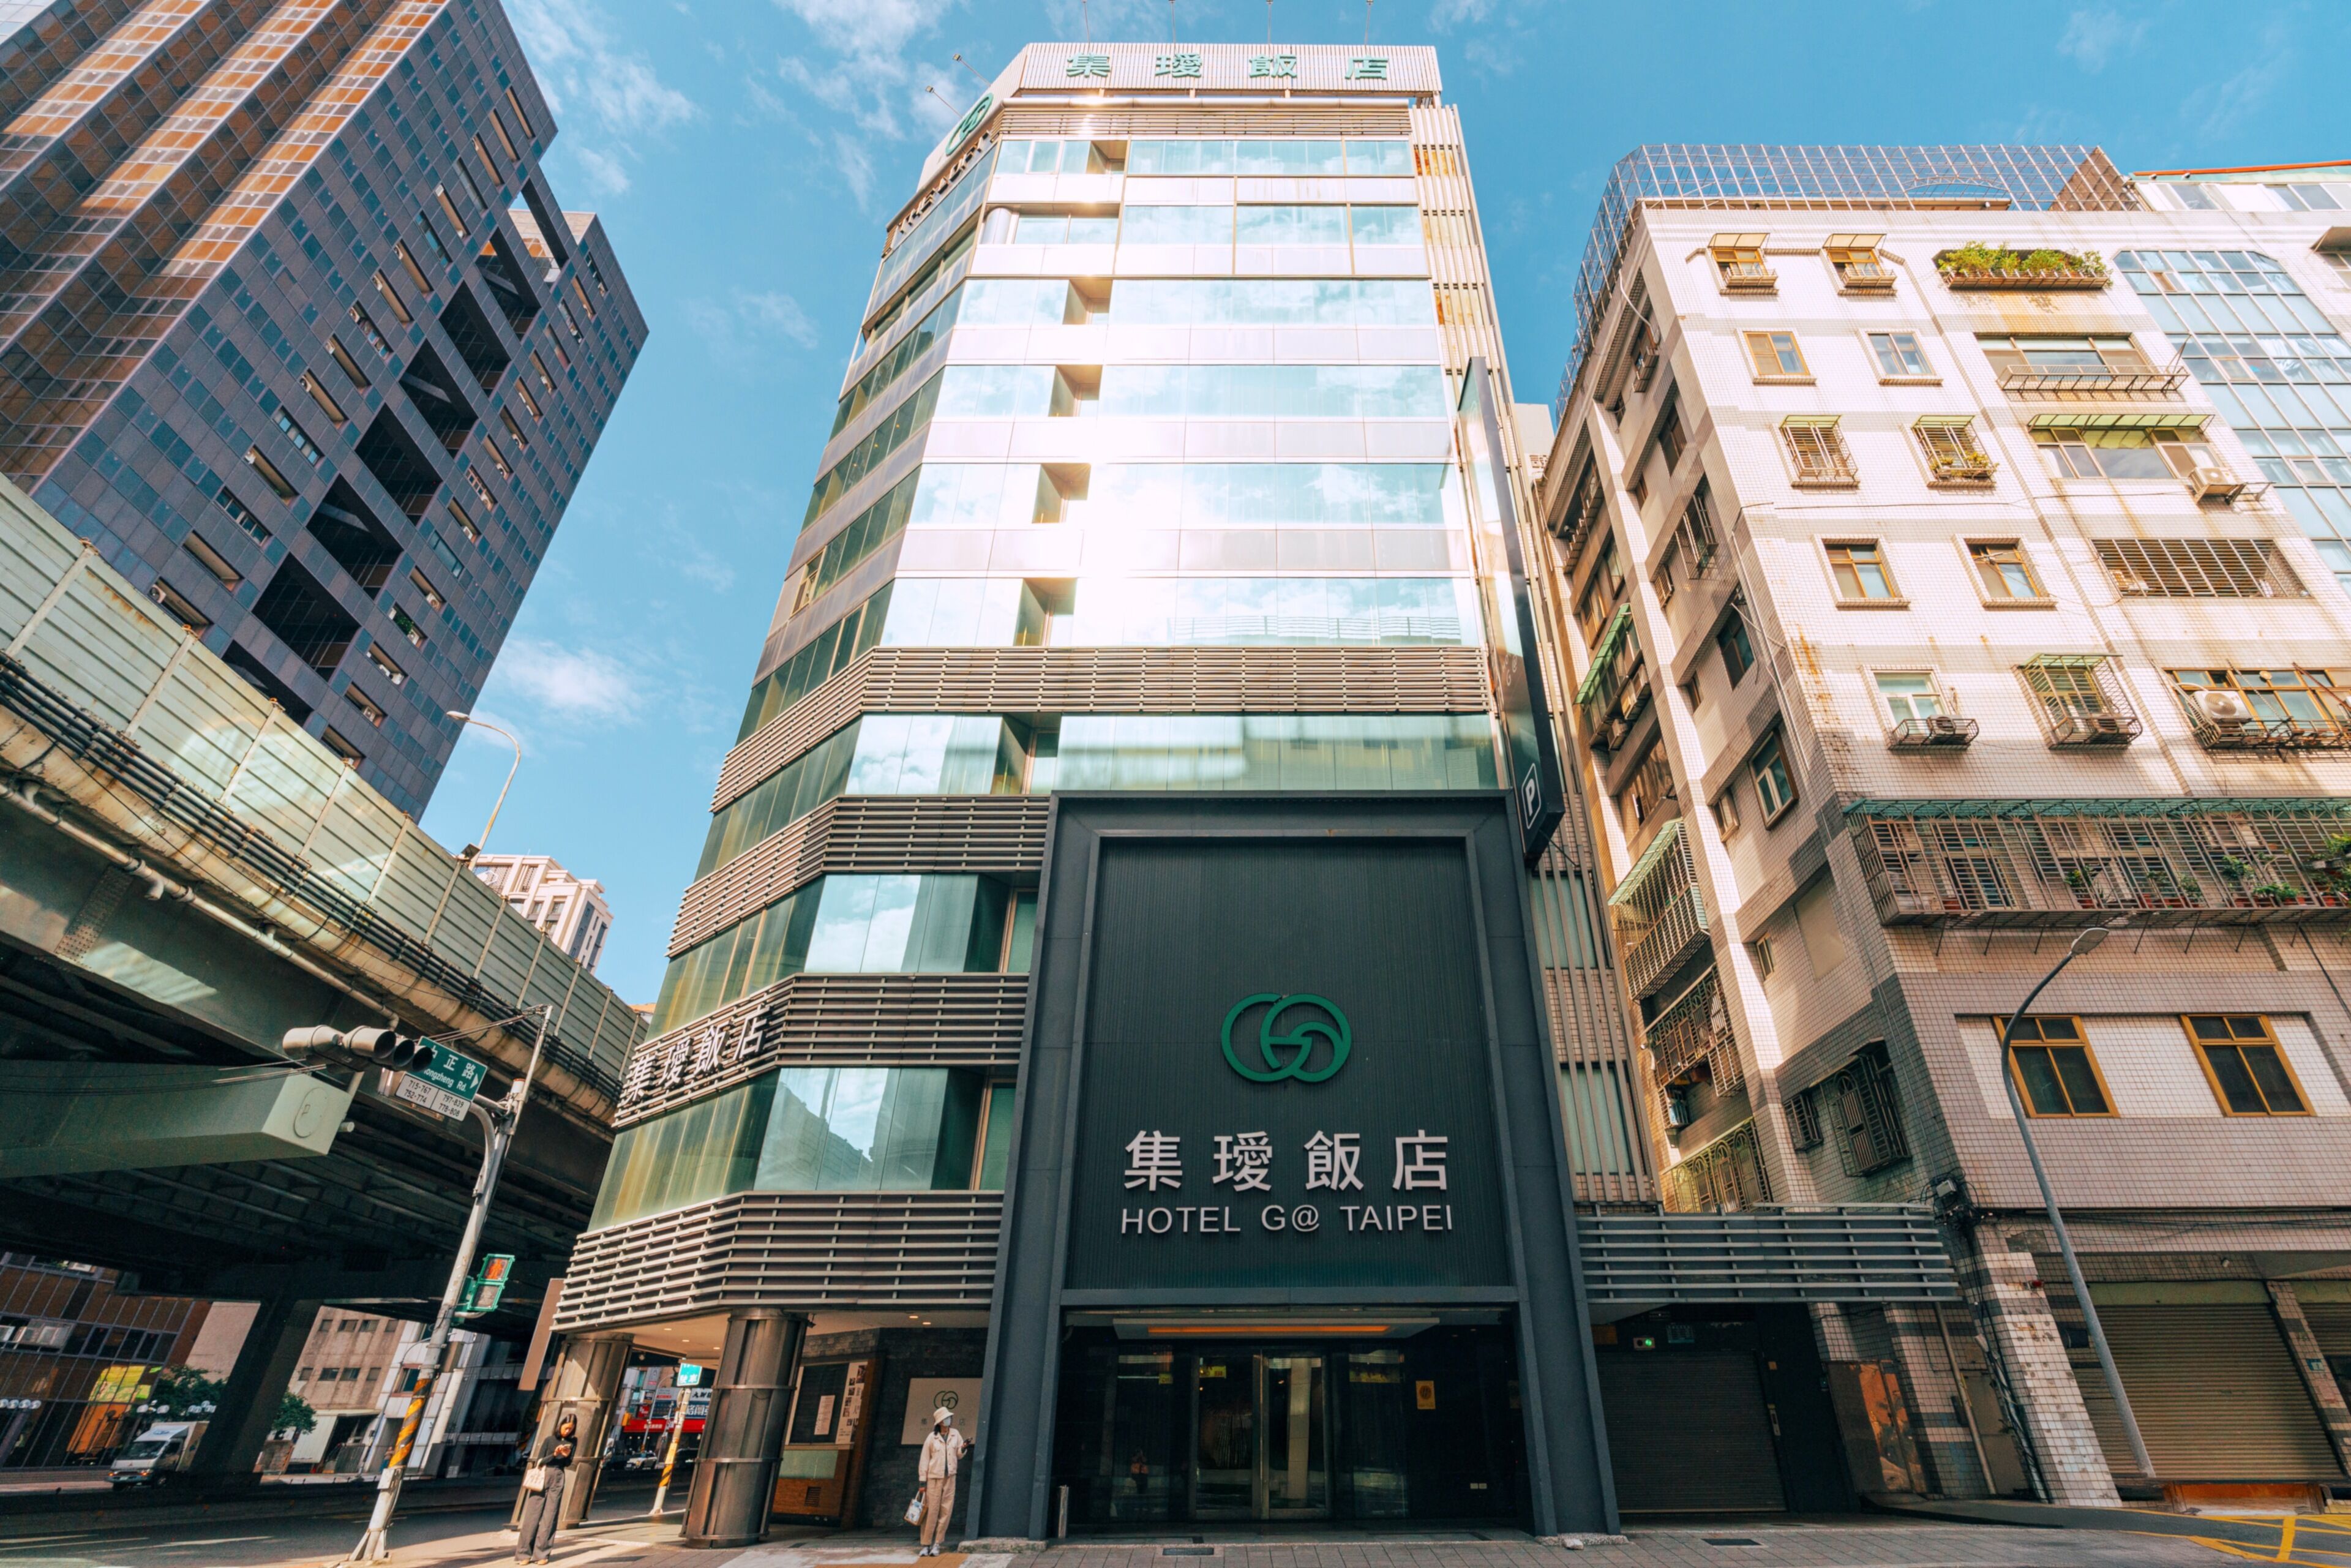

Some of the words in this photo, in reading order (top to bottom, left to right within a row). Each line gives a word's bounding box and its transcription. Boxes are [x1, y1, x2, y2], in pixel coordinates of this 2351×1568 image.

[1066, 53, 1389, 80] 集璦飯店
[1525, 778, 1535, 816] P
[1124, 1130, 1449, 1192] 集璦飯店
[1121, 1207, 1241, 1234] HOTEL
[1261, 1205, 1321, 1232] G@
[1340, 1205, 1453, 1232] TAIPEI
